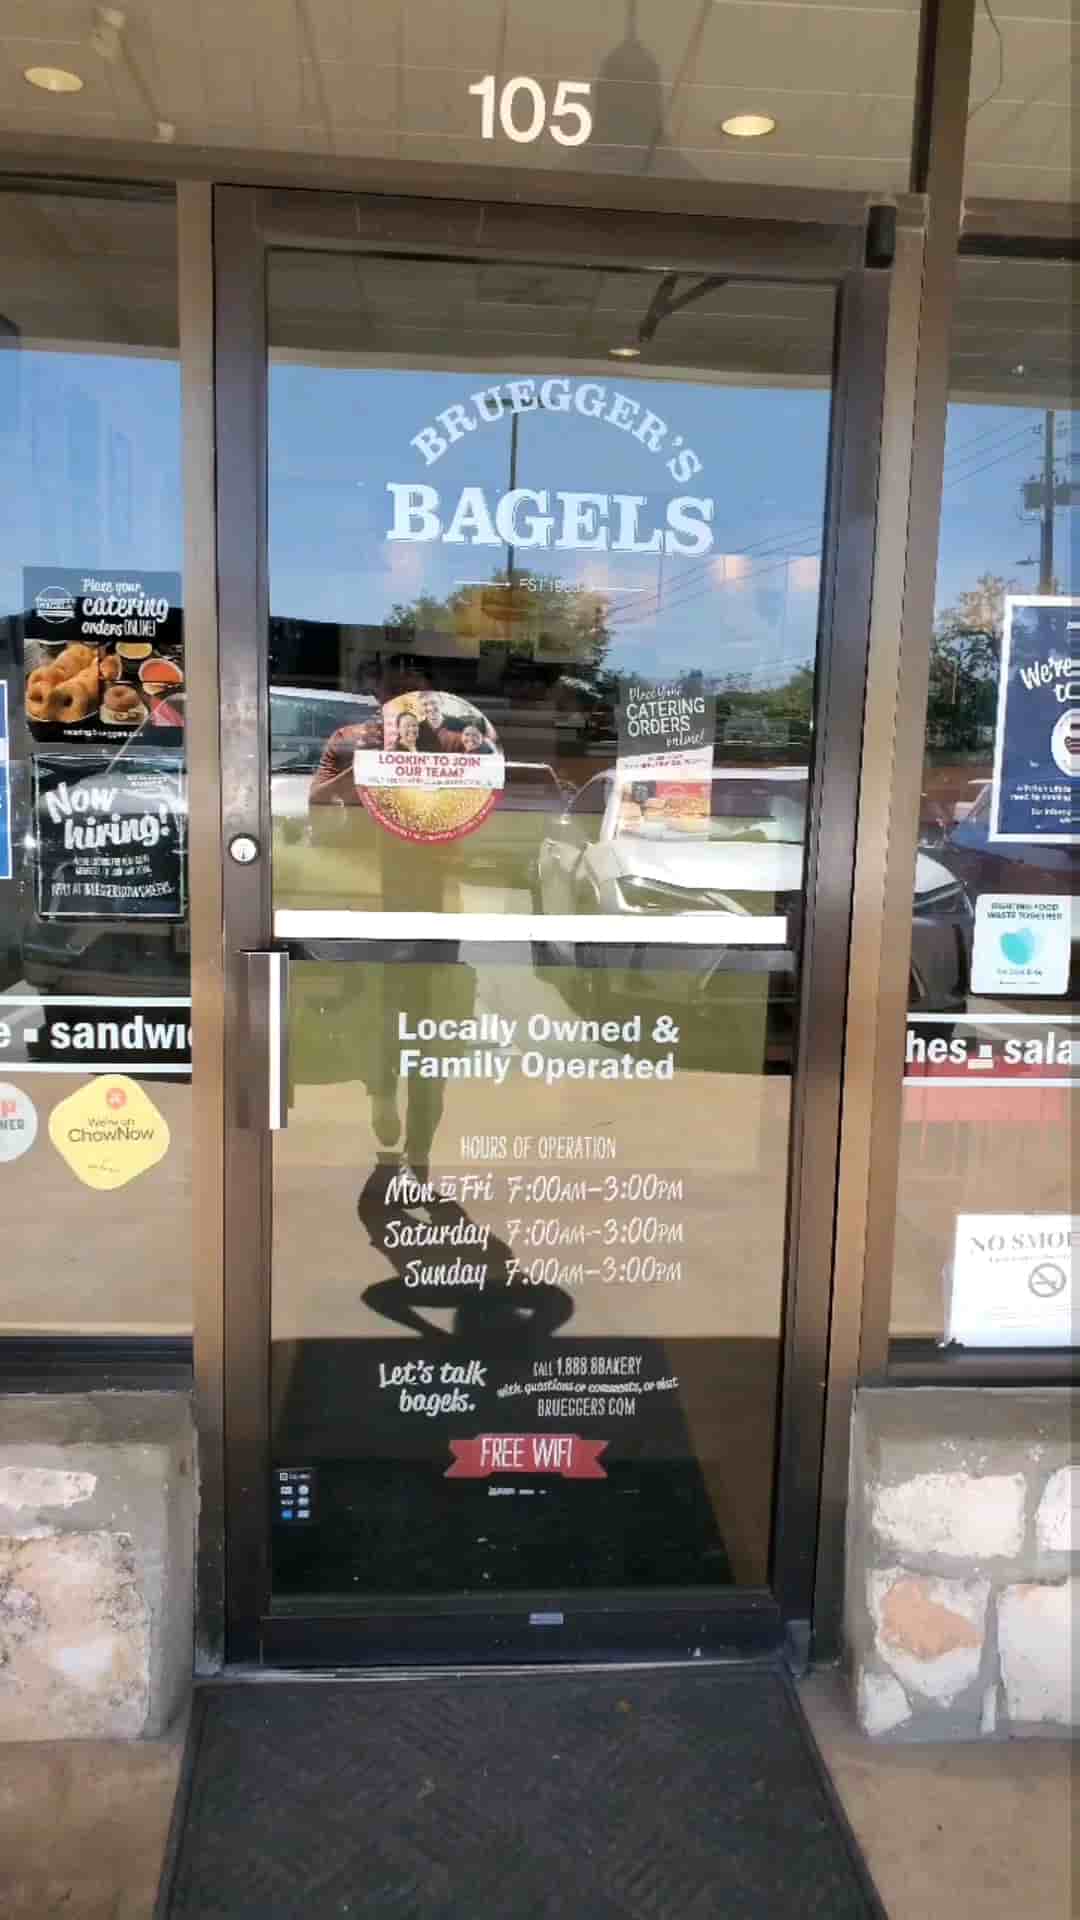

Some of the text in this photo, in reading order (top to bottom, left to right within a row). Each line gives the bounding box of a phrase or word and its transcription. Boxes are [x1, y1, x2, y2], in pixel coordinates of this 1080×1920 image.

[467, 74, 592, 146] 105
[410, 378, 702, 483] BRUEGGER'S
[386, 482, 714, 556] BAGELS
[82, 592, 168, 623] catering
[81, 620, 123, 637] orders
[626, 697, 705, 720] CATERING
[628, 715, 690, 737] ORDERS
[395, 766, 465, 778] OUR TEAM?
[434, 755, 449, 766] TO
[452, 756, 481, 767] JOIN
[46, 782, 118, 824] Now
[64, 804, 170, 849] hiring!
[50, 1015, 192, 1049] sandwi
[398, 1012, 681, 1047] Locally Owned &
[400, 1050, 675, 1084] Family Operated
[67, 1126, 155, 1143] ChowNow
[460, 1136, 617, 1160] HOURS OF OPERATION
[384, 1174, 436, 1205] Mon
[459, 1173, 495, 1202] Fri
[384, 1217, 492, 1250] Saturday
[404, 1257, 488, 1290] Sunday
[378, 1359, 488, 1388] Let's talk
[399, 1388, 476, 1417] bagels.
[480, 1438, 574, 1468] FREE WIFI
